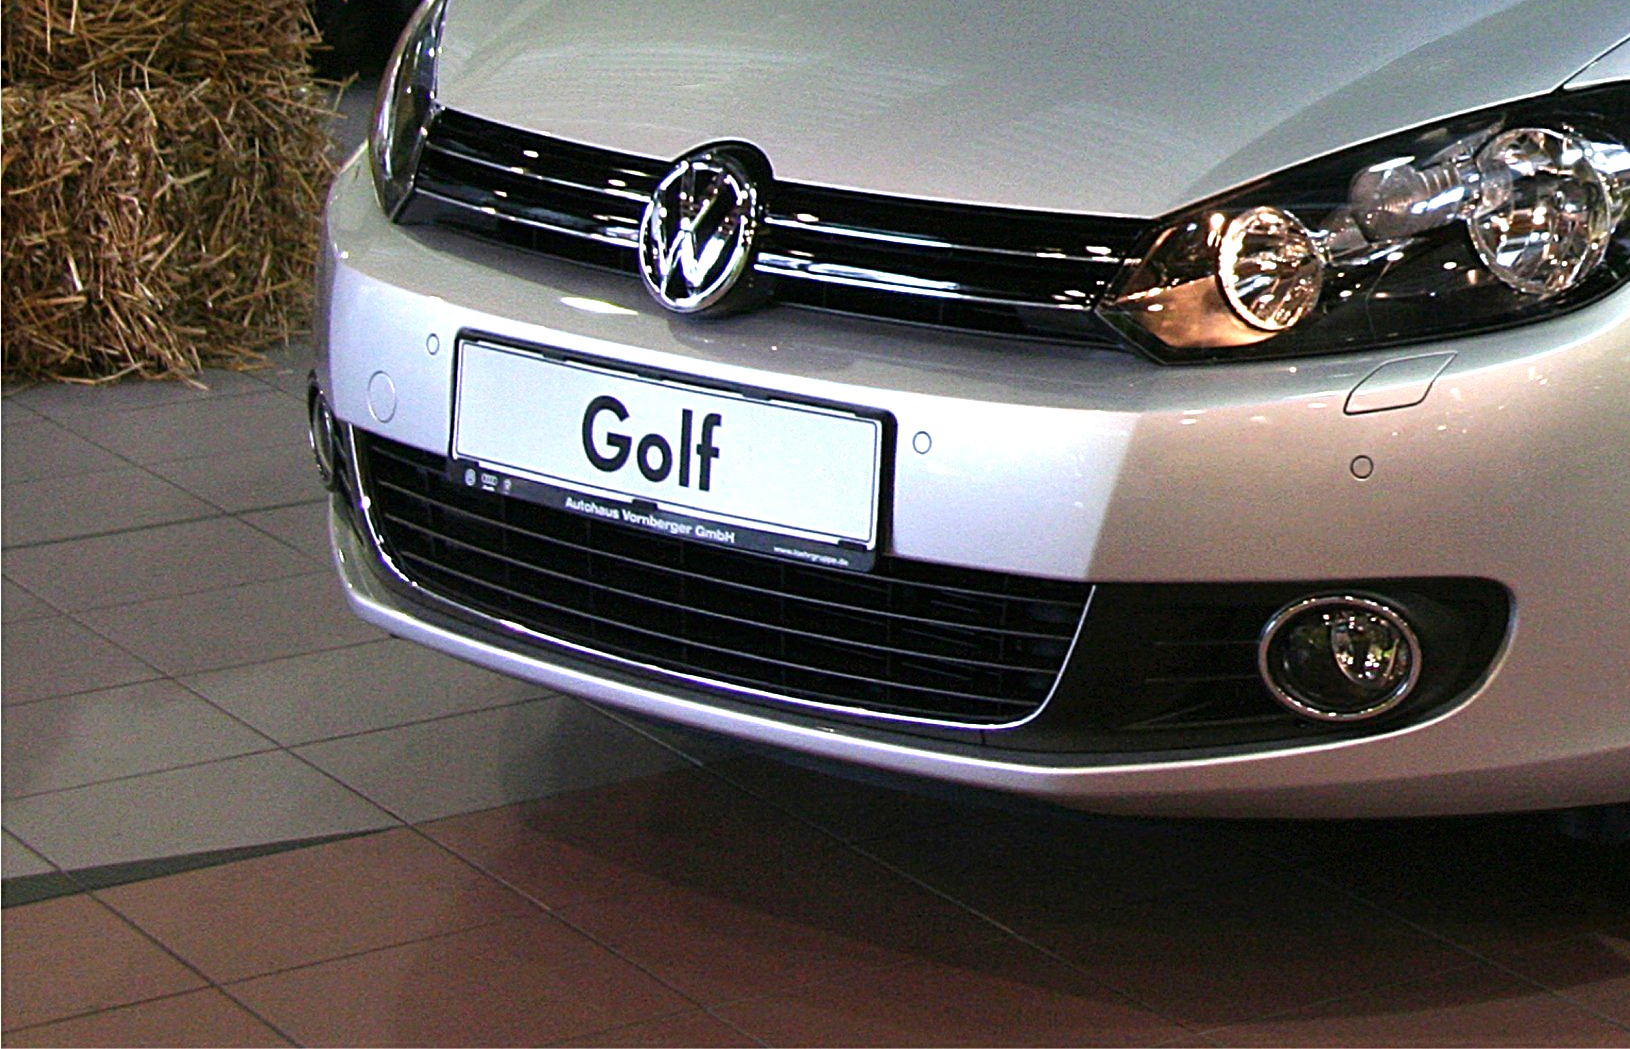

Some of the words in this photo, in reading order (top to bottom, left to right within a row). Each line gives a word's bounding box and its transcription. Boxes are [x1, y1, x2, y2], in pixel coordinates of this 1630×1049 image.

[642, 155, 750, 311] VW
[582, 395, 723, 492] Golf
[565, 497, 620, 520] Autohaus
[622, 509, 693, 535] Vornberger
[695, 525, 735, 544] GmbH
